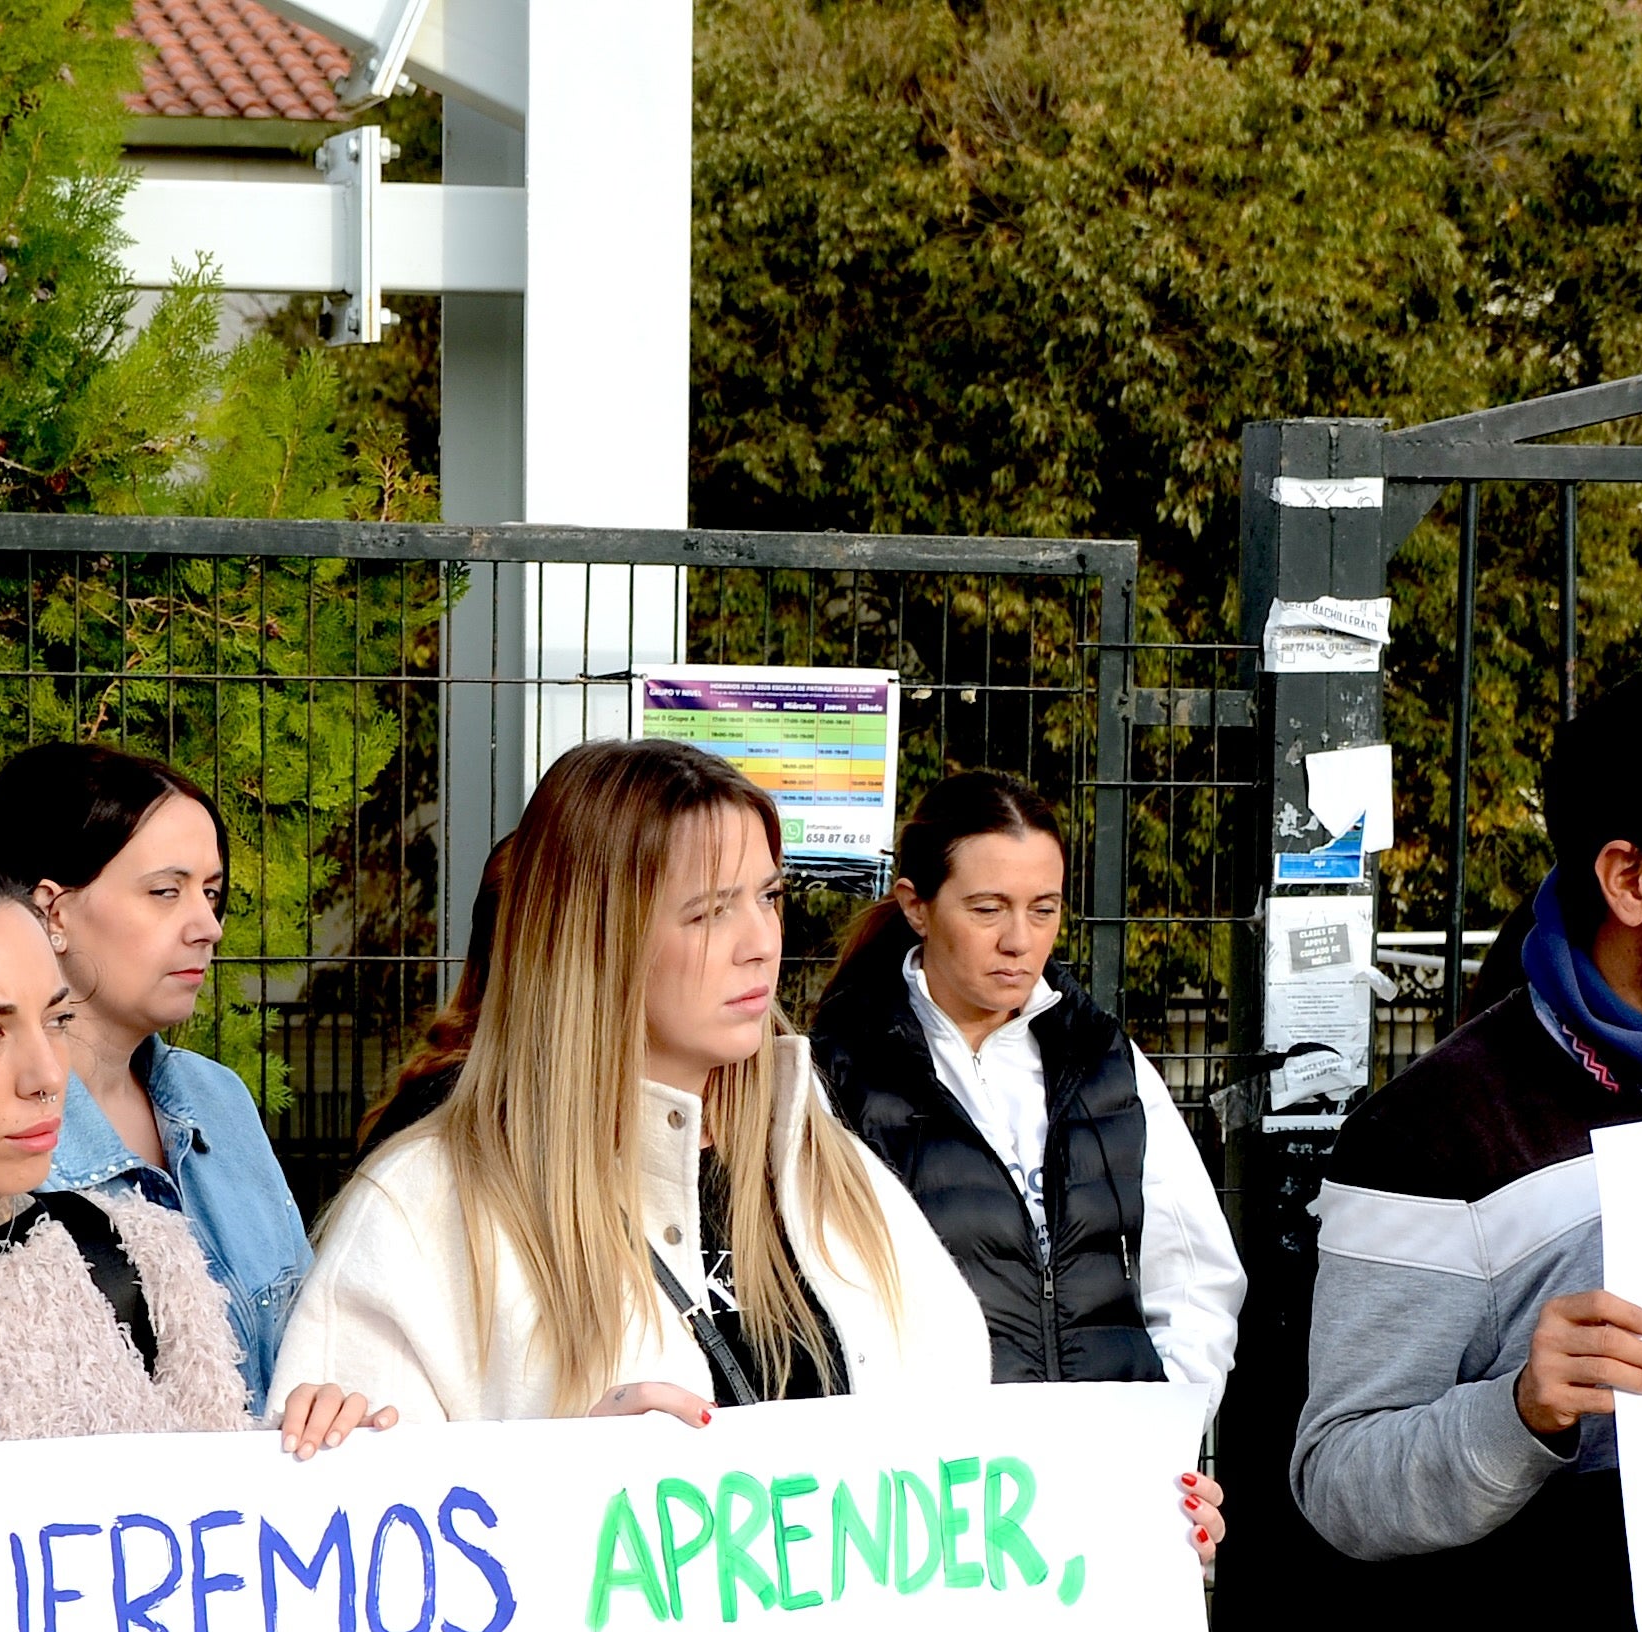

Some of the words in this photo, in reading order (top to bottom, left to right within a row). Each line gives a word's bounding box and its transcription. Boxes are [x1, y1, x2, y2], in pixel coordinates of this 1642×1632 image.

[1312, 603, 1379, 633] BACHILLERATO
[649, 688, 674, 697] GRUPO
[717, 701, 738, 709] Lunes
[752, 701, 777, 710] Martes
[783, 701, 817, 711] Miércoles
[824, 703, 847, 712] Jueves
[857, 703, 883, 712] Sábado
[806, 833, 825, 843] 658
[828, 834, 841, 843] 87
[843, 834, 856, 843] 62
[859, 834, 871, 844] 68
[586, 1456, 1085, 1632] APRENDER,
